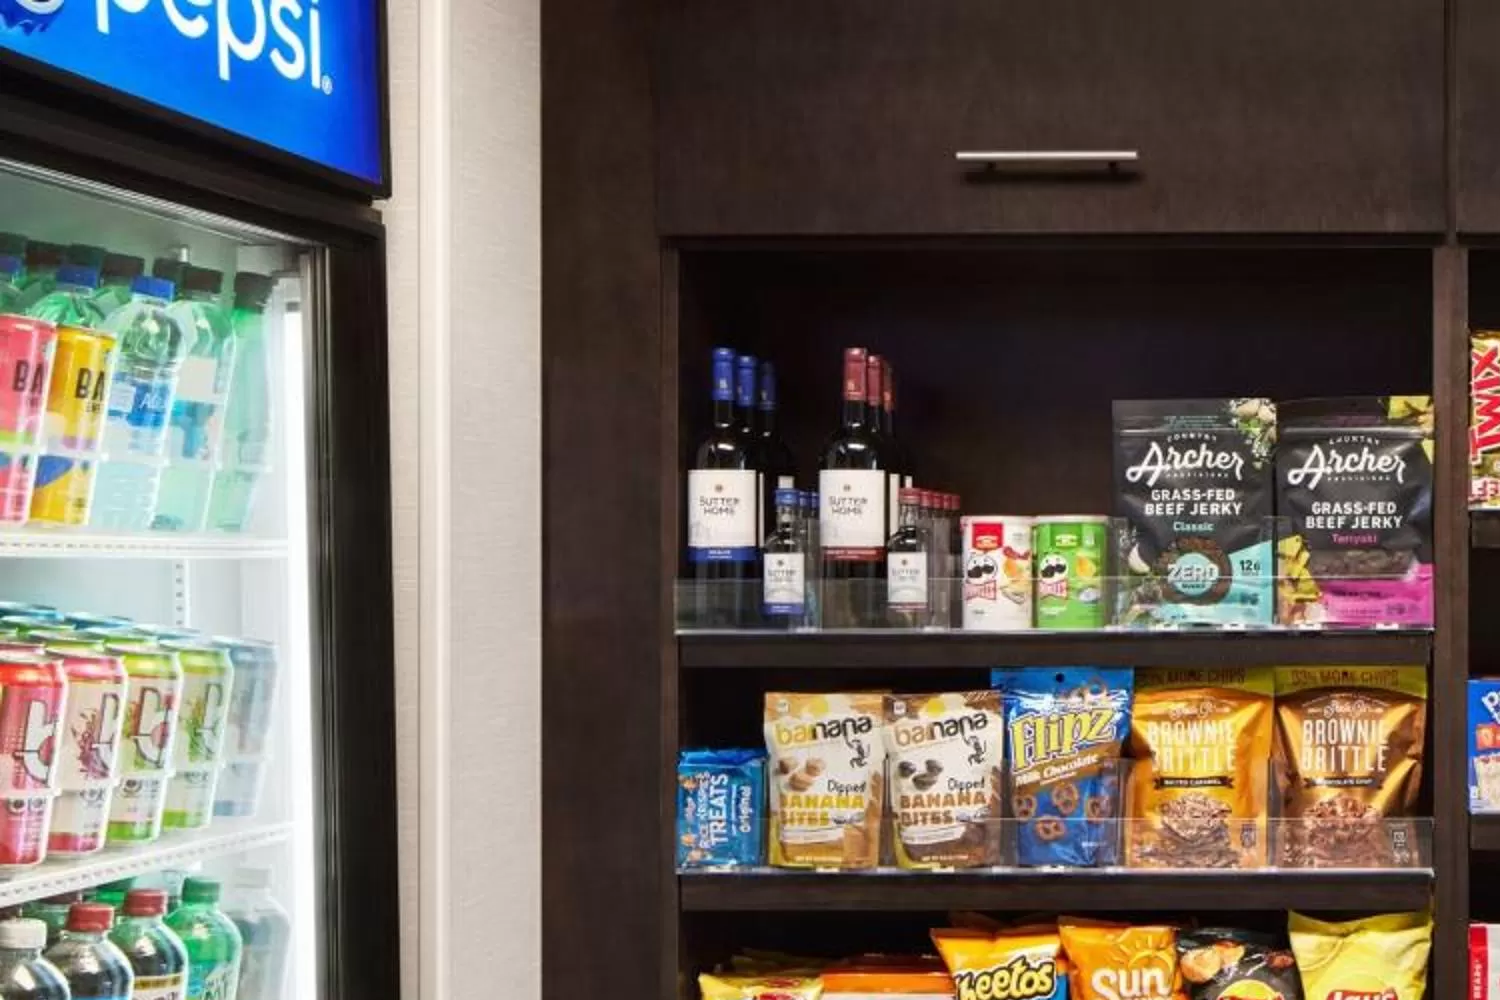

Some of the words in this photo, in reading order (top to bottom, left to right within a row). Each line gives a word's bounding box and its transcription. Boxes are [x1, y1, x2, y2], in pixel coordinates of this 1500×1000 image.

[1126, 441, 1245, 487] Archer
[1287, 444, 1407, 490] Archer
[1151, 488, 1236, 501] GRASS-FED
[1145, 503, 1185, 515] BEEF
[1190, 502, 1242, 515] JERKY
[1311, 502, 1397, 514] GRASS-FED
[1173, 520, 1214, 532] Classic
[1305, 516, 1345, 529] BEEF
[1351, 516, 1403, 529] JERKY
[1332, 533, 1378, 545] Teriyaki
[1167, 563, 1220, 583] ZERO
[1148, 719, 1237, 745] BROWNIE
[1303, 719, 1389, 745] BROWNIE
[1151, 747, 1237, 772] BRITTLE
[1302, 746, 1389, 773] BRITTLE
[1015, 770, 1042, 787] Milk
[1042, 754, 1100, 778] Chocolate
[827, 779, 867, 797] Dipped
[947, 777, 986, 792] Dipped
[709, 773, 729, 846] TREATS
[739, 785, 754, 833] Original
[782, 795, 865, 809] BANANA
[901, 791, 987, 810] BANANA
[782, 811, 830, 827] BITES
[901, 810, 955, 827] BITES
